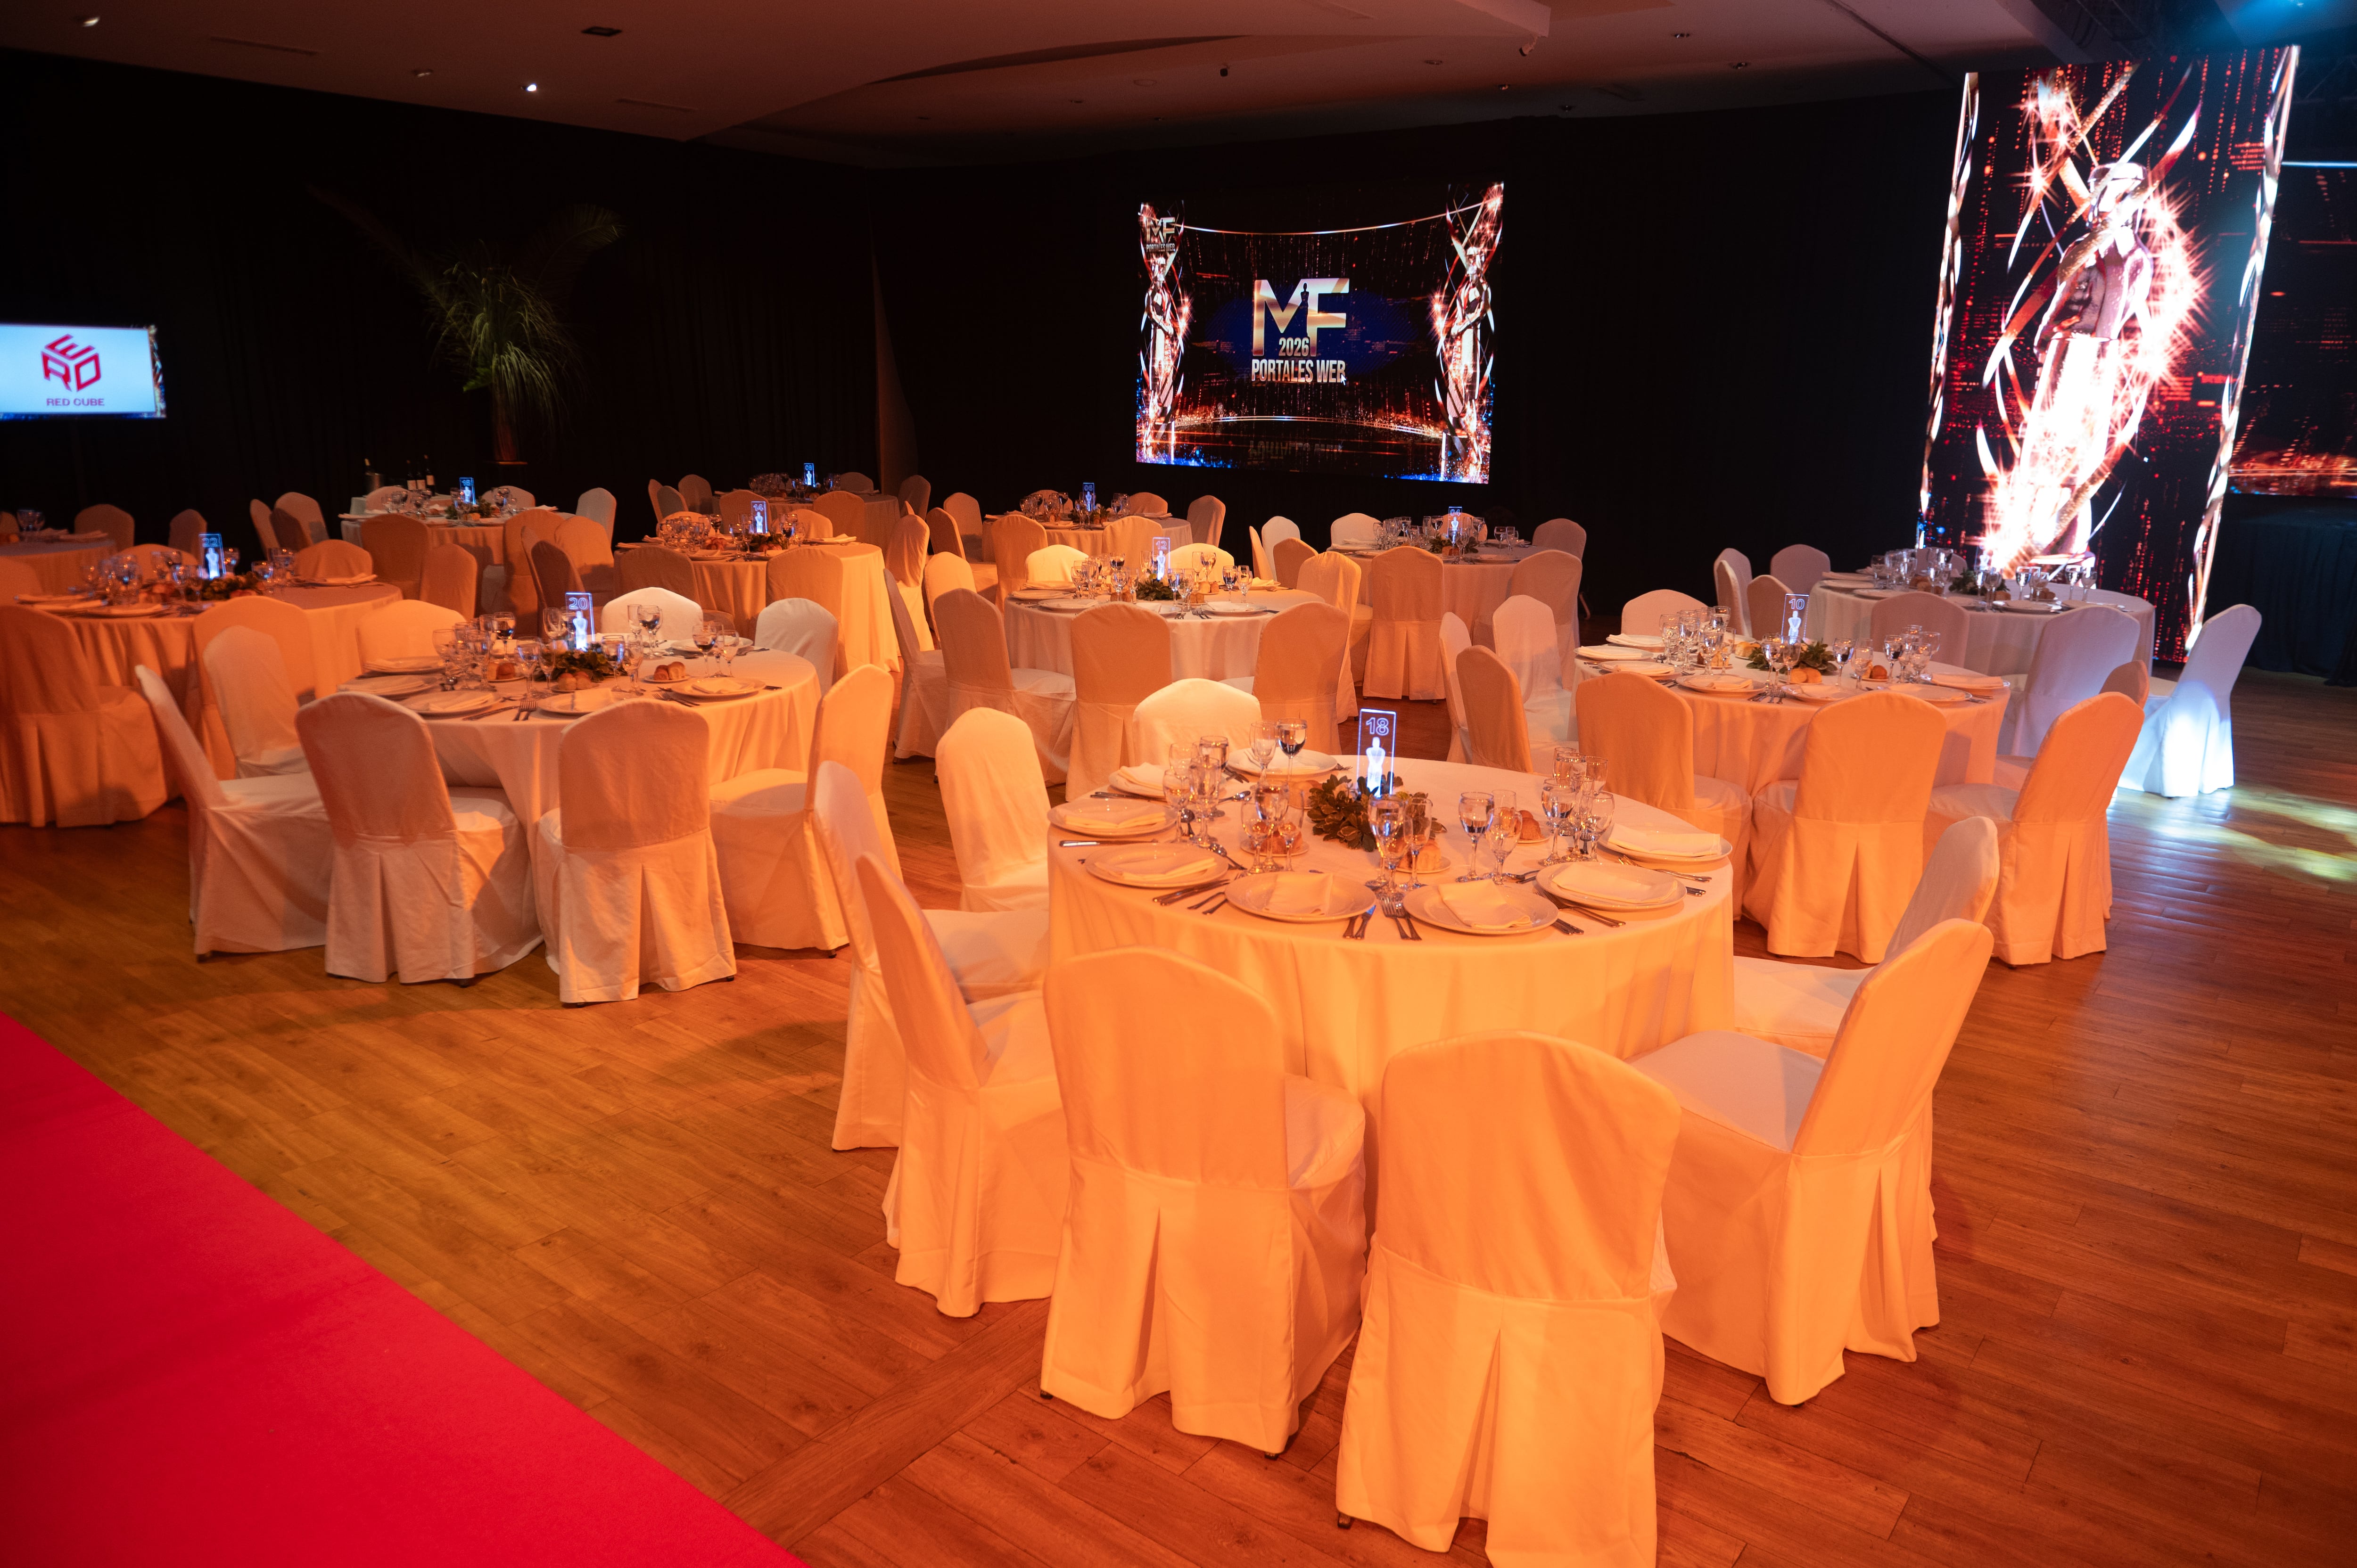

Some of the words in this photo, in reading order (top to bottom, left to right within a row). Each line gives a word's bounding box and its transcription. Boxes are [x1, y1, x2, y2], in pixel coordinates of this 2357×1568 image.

[1146, 244, 1166, 252] PORTALES
[1253, 278, 1350, 357] MF
[1278, 337, 1309, 356] 2026
[1252, 359, 1314, 383] PORTALES
[1316, 360, 1346, 383] WEB
[46, 398, 70, 406] RED
[73, 398, 105, 406] CUBE
[202, 537, 218, 547] 22
[1156, 541, 1167, 550] 12
[569, 597, 588, 609] 20
[1788, 598, 1805, 610] 10
[1366, 717, 1389, 736] 18
